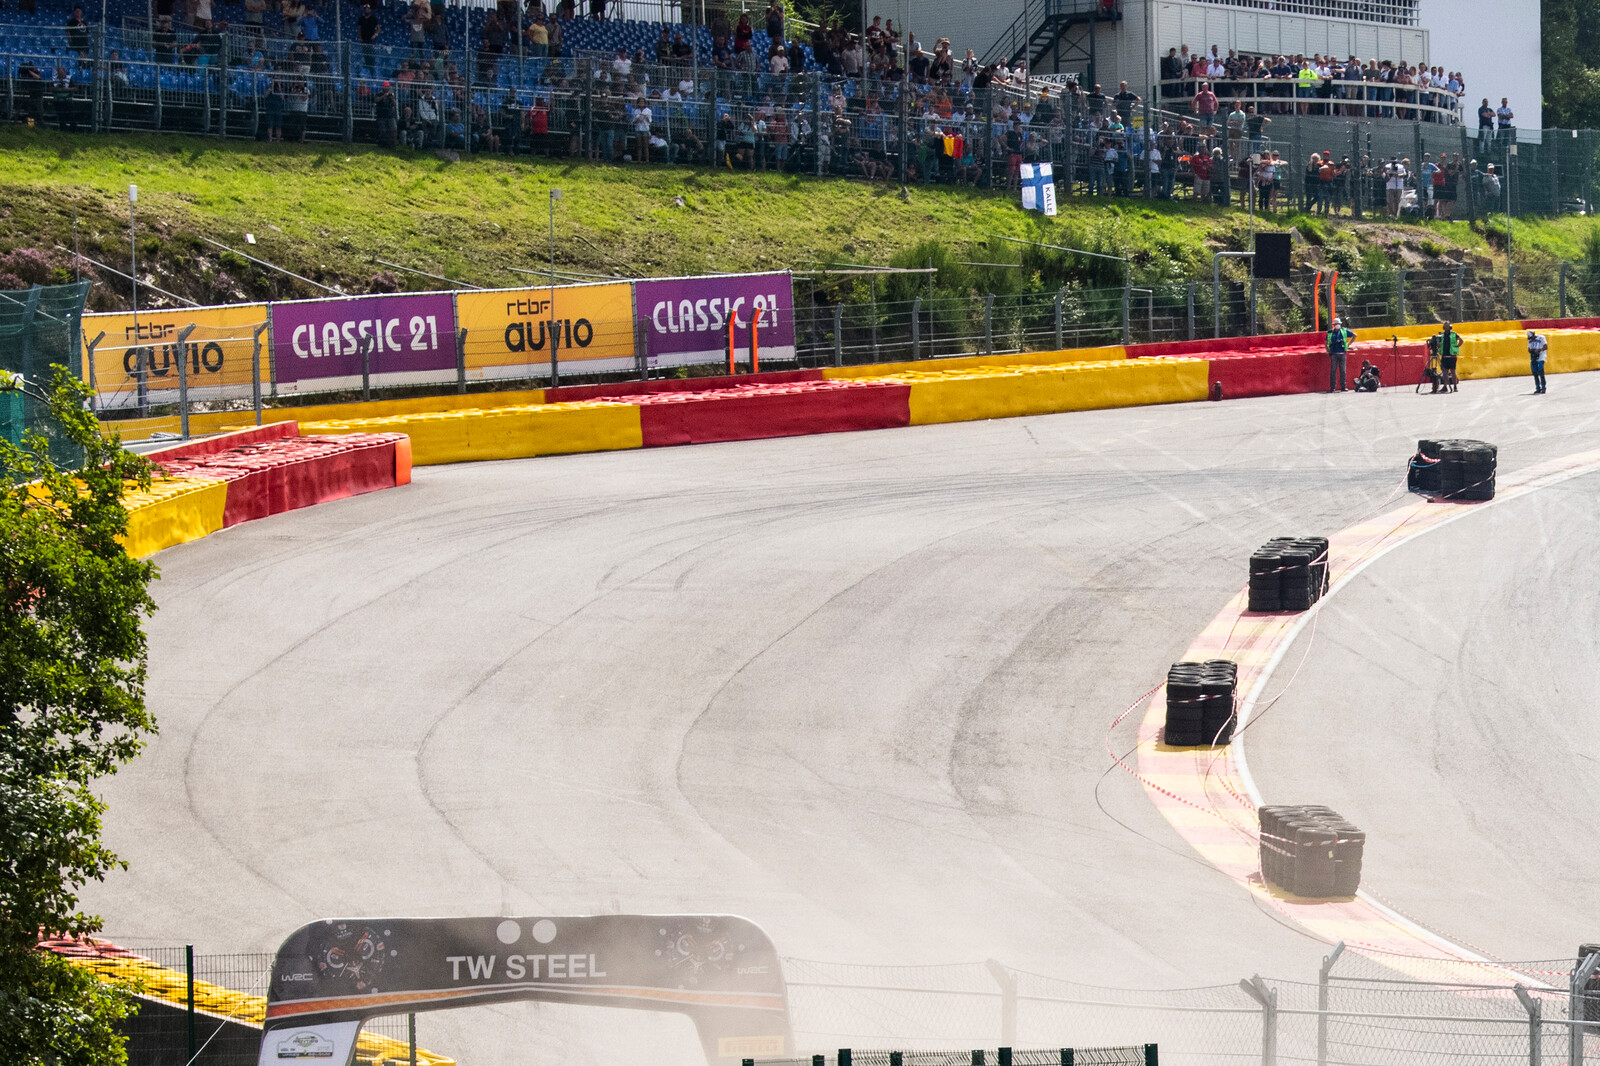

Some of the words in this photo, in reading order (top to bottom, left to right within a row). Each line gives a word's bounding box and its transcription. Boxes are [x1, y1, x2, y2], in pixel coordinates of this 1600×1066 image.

[1045, 187, 1053, 213] KALLE
[507, 298, 550, 317] rtbf
[652, 296, 745, 334] CLASSIC
[755, 294, 778, 328] 21
[125, 322, 175, 341] rtbf
[292, 318, 401, 359] CLASSIC
[410, 315, 438, 351] 21
[504, 317, 594, 352] auvio
[281, 973, 313, 981] WRC
[446, 955, 496, 981] TW
[506, 954, 607, 980] STEEL
[737, 966, 769, 974] WRC
